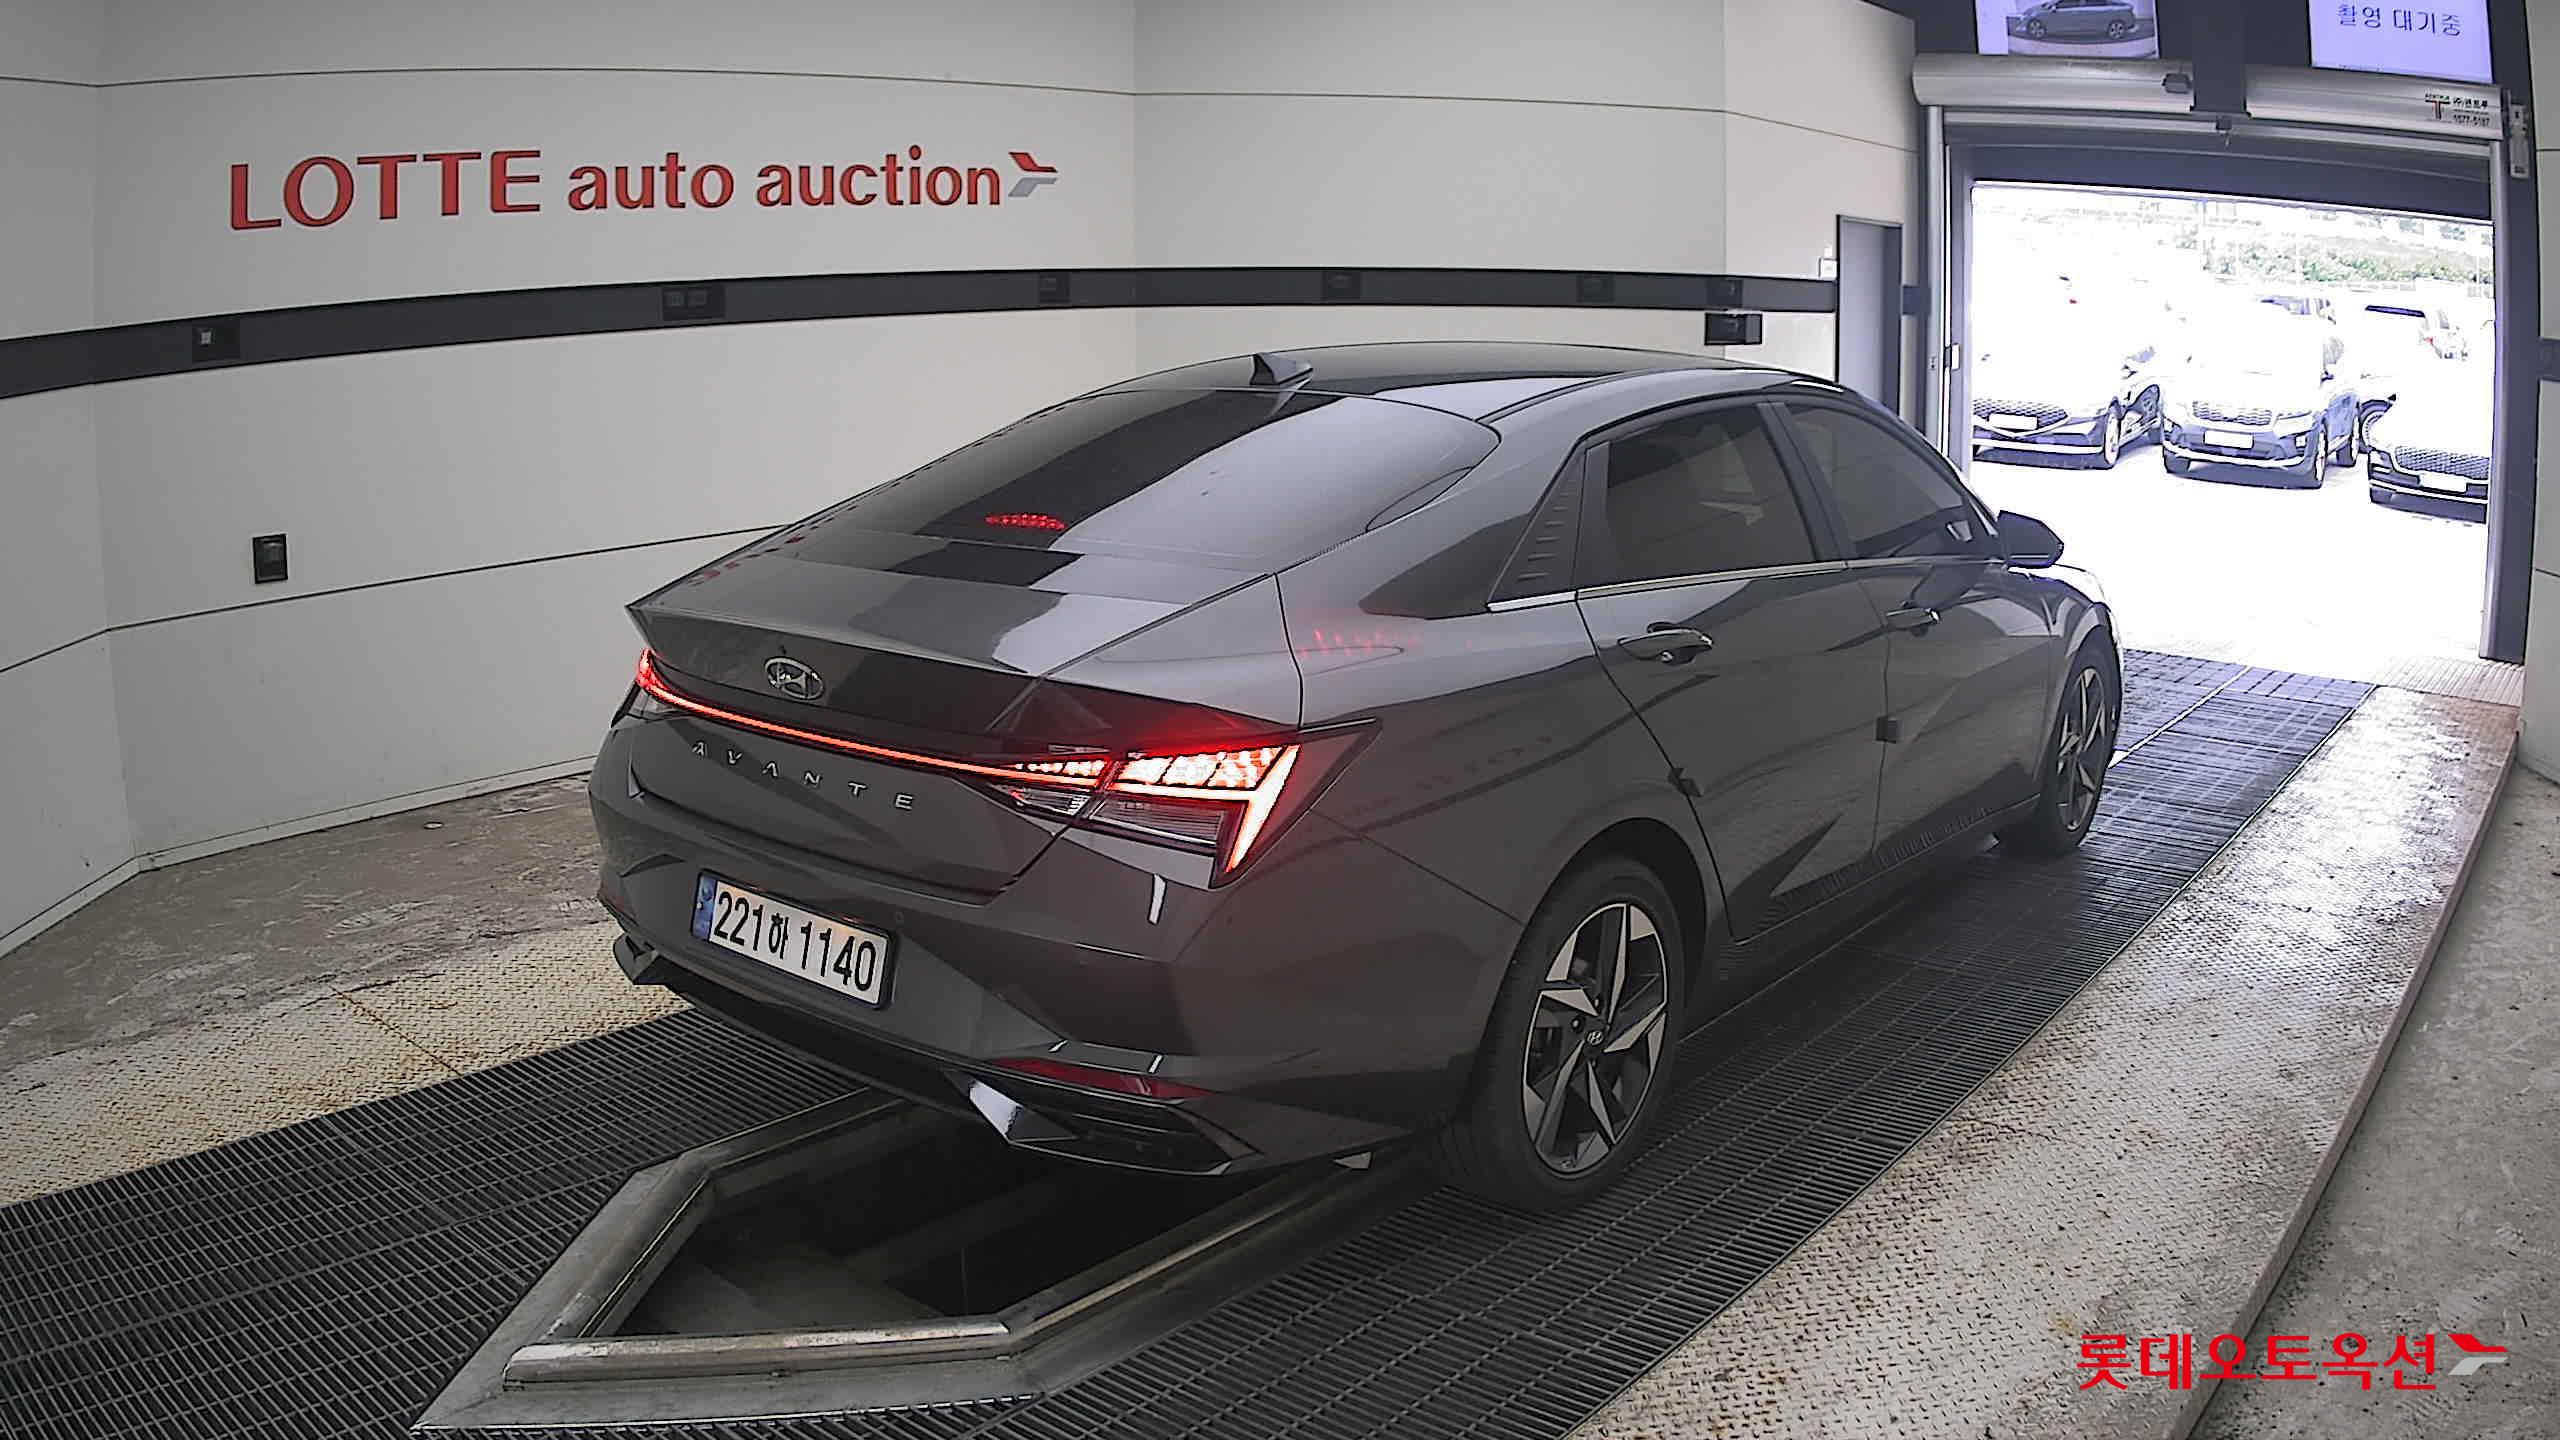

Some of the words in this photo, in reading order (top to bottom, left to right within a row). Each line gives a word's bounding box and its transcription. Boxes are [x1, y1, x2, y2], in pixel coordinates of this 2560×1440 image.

[2337, 4, 2381, 29] 촬영
[2393, 9, 2461, 36] 대기중
[230, 149, 541, 230] LOTTE
[568, 153, 735, 211] auto
[755, 144, 1001, 208] auction
[692, 741, 913, 810] AVANTE
[713, 891, 789, 959] 221하
[801, 921, 876, 991] 1140
